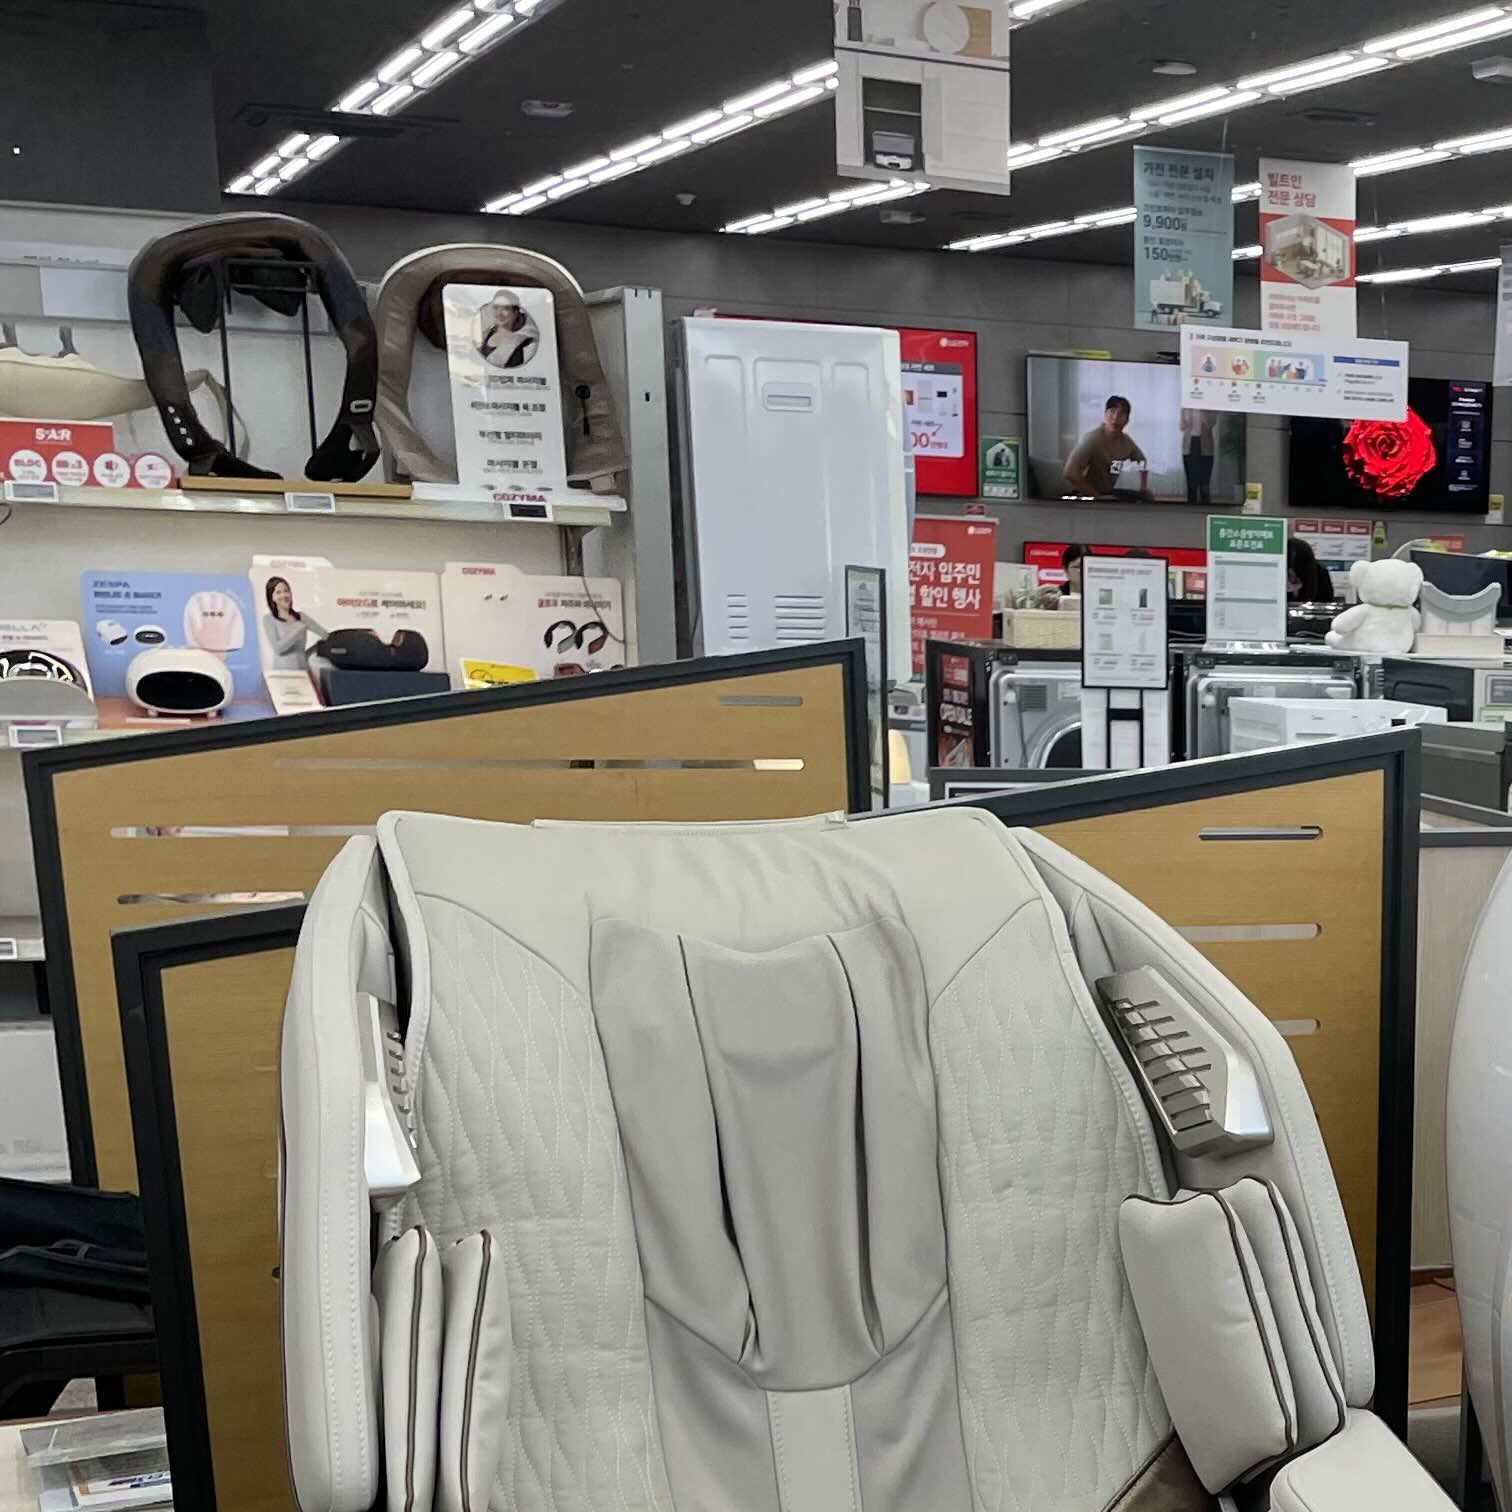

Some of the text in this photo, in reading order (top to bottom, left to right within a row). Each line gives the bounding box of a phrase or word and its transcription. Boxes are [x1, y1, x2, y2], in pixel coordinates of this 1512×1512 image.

[1267, 172, 1303, 190] 빌트인
[1268, 190, 1316, 209] 전문 상담
[938, 562, 981, 585] 입주민
[919, 585, 981, 610] 할인 행사
